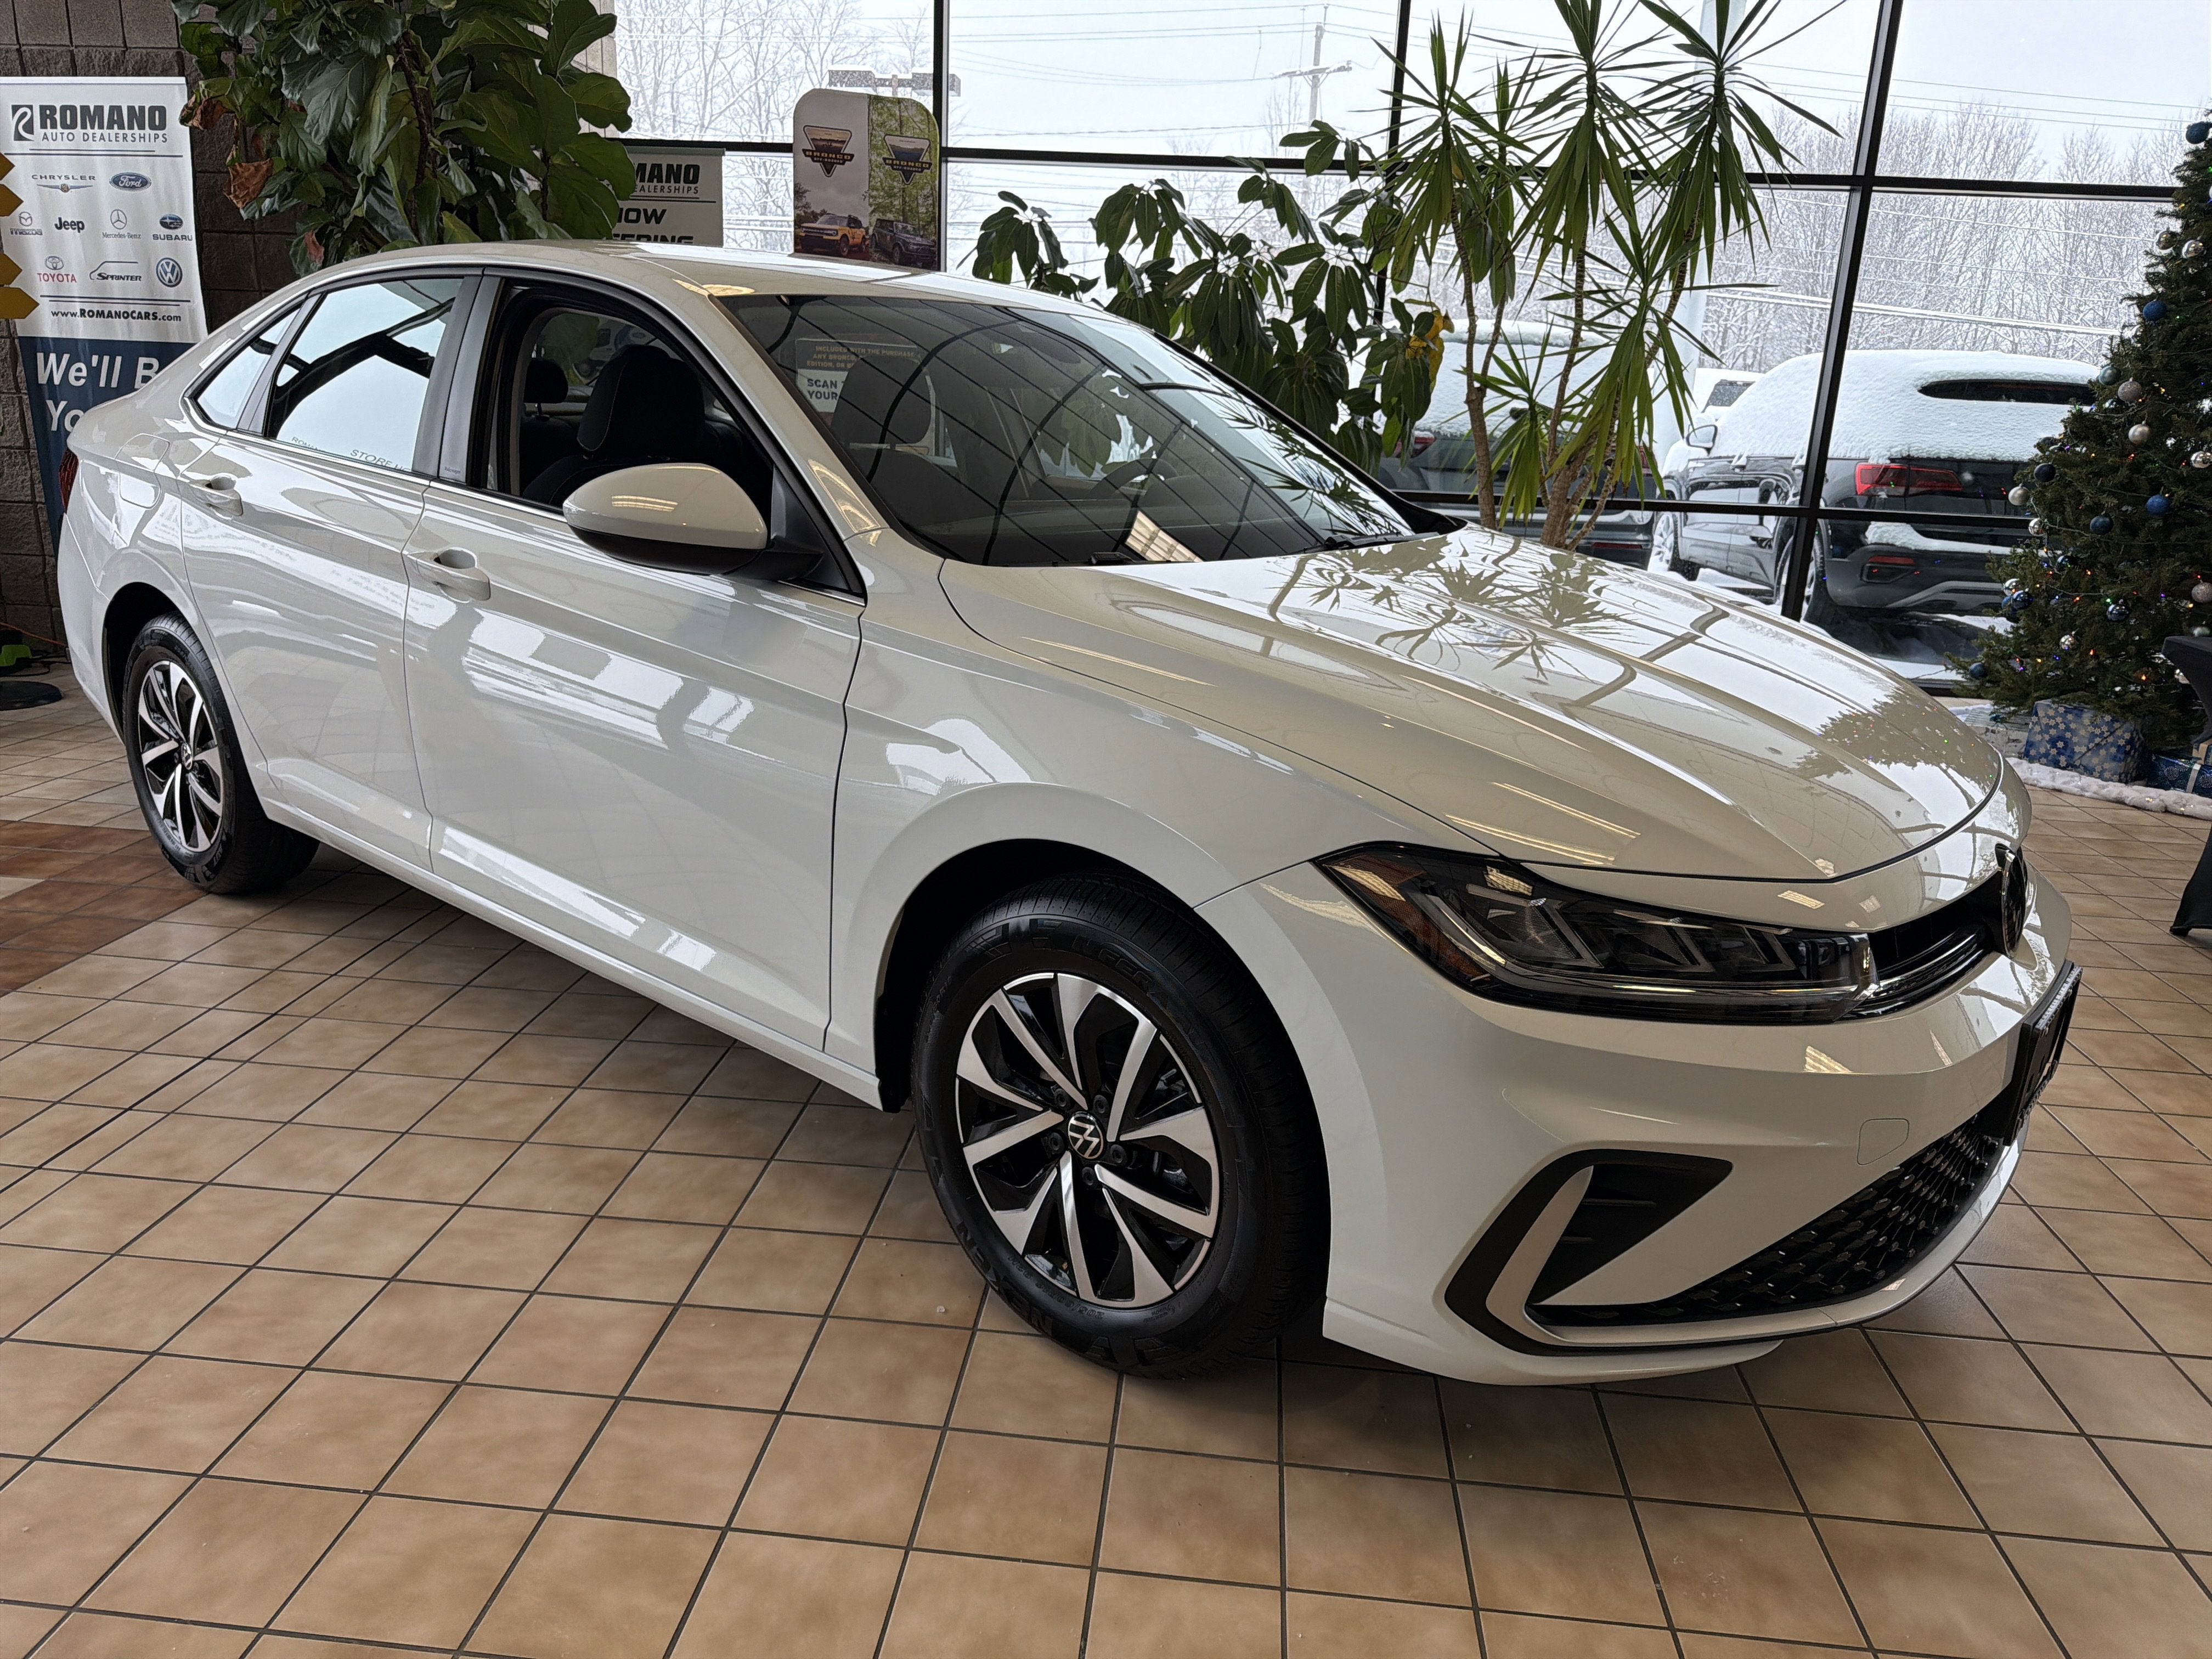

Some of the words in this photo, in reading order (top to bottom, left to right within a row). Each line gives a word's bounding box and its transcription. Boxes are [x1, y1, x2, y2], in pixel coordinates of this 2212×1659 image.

[39, 104, 167, 131] ROMANO
[42, 132, 75, 142] AUTO
[83, 132, 167, 143] DEALERSHIPS
[806, 151, 851, 160] BRONCO
[886, 160, 929, 168] BRONCO
[635, 163, 700, 184] MANO
[634, 184, 698, 194] EALERSHIPS
[54, 217, 85, 233] Jeep
[102, 232, 141, 240] Mercedes-Benz
[37, 273, 77, 283] TOYOTA
[96, 272, 142, 281] SPRINTER
[51, 308, 181, 322] www.ROMANOCARS.com
[37, 352, 122, 387] We'll
[807, 378, 838, 390] SCAN
[807, 390, 838, 400] YOUR
[350, 449, 393, 466] STORE
